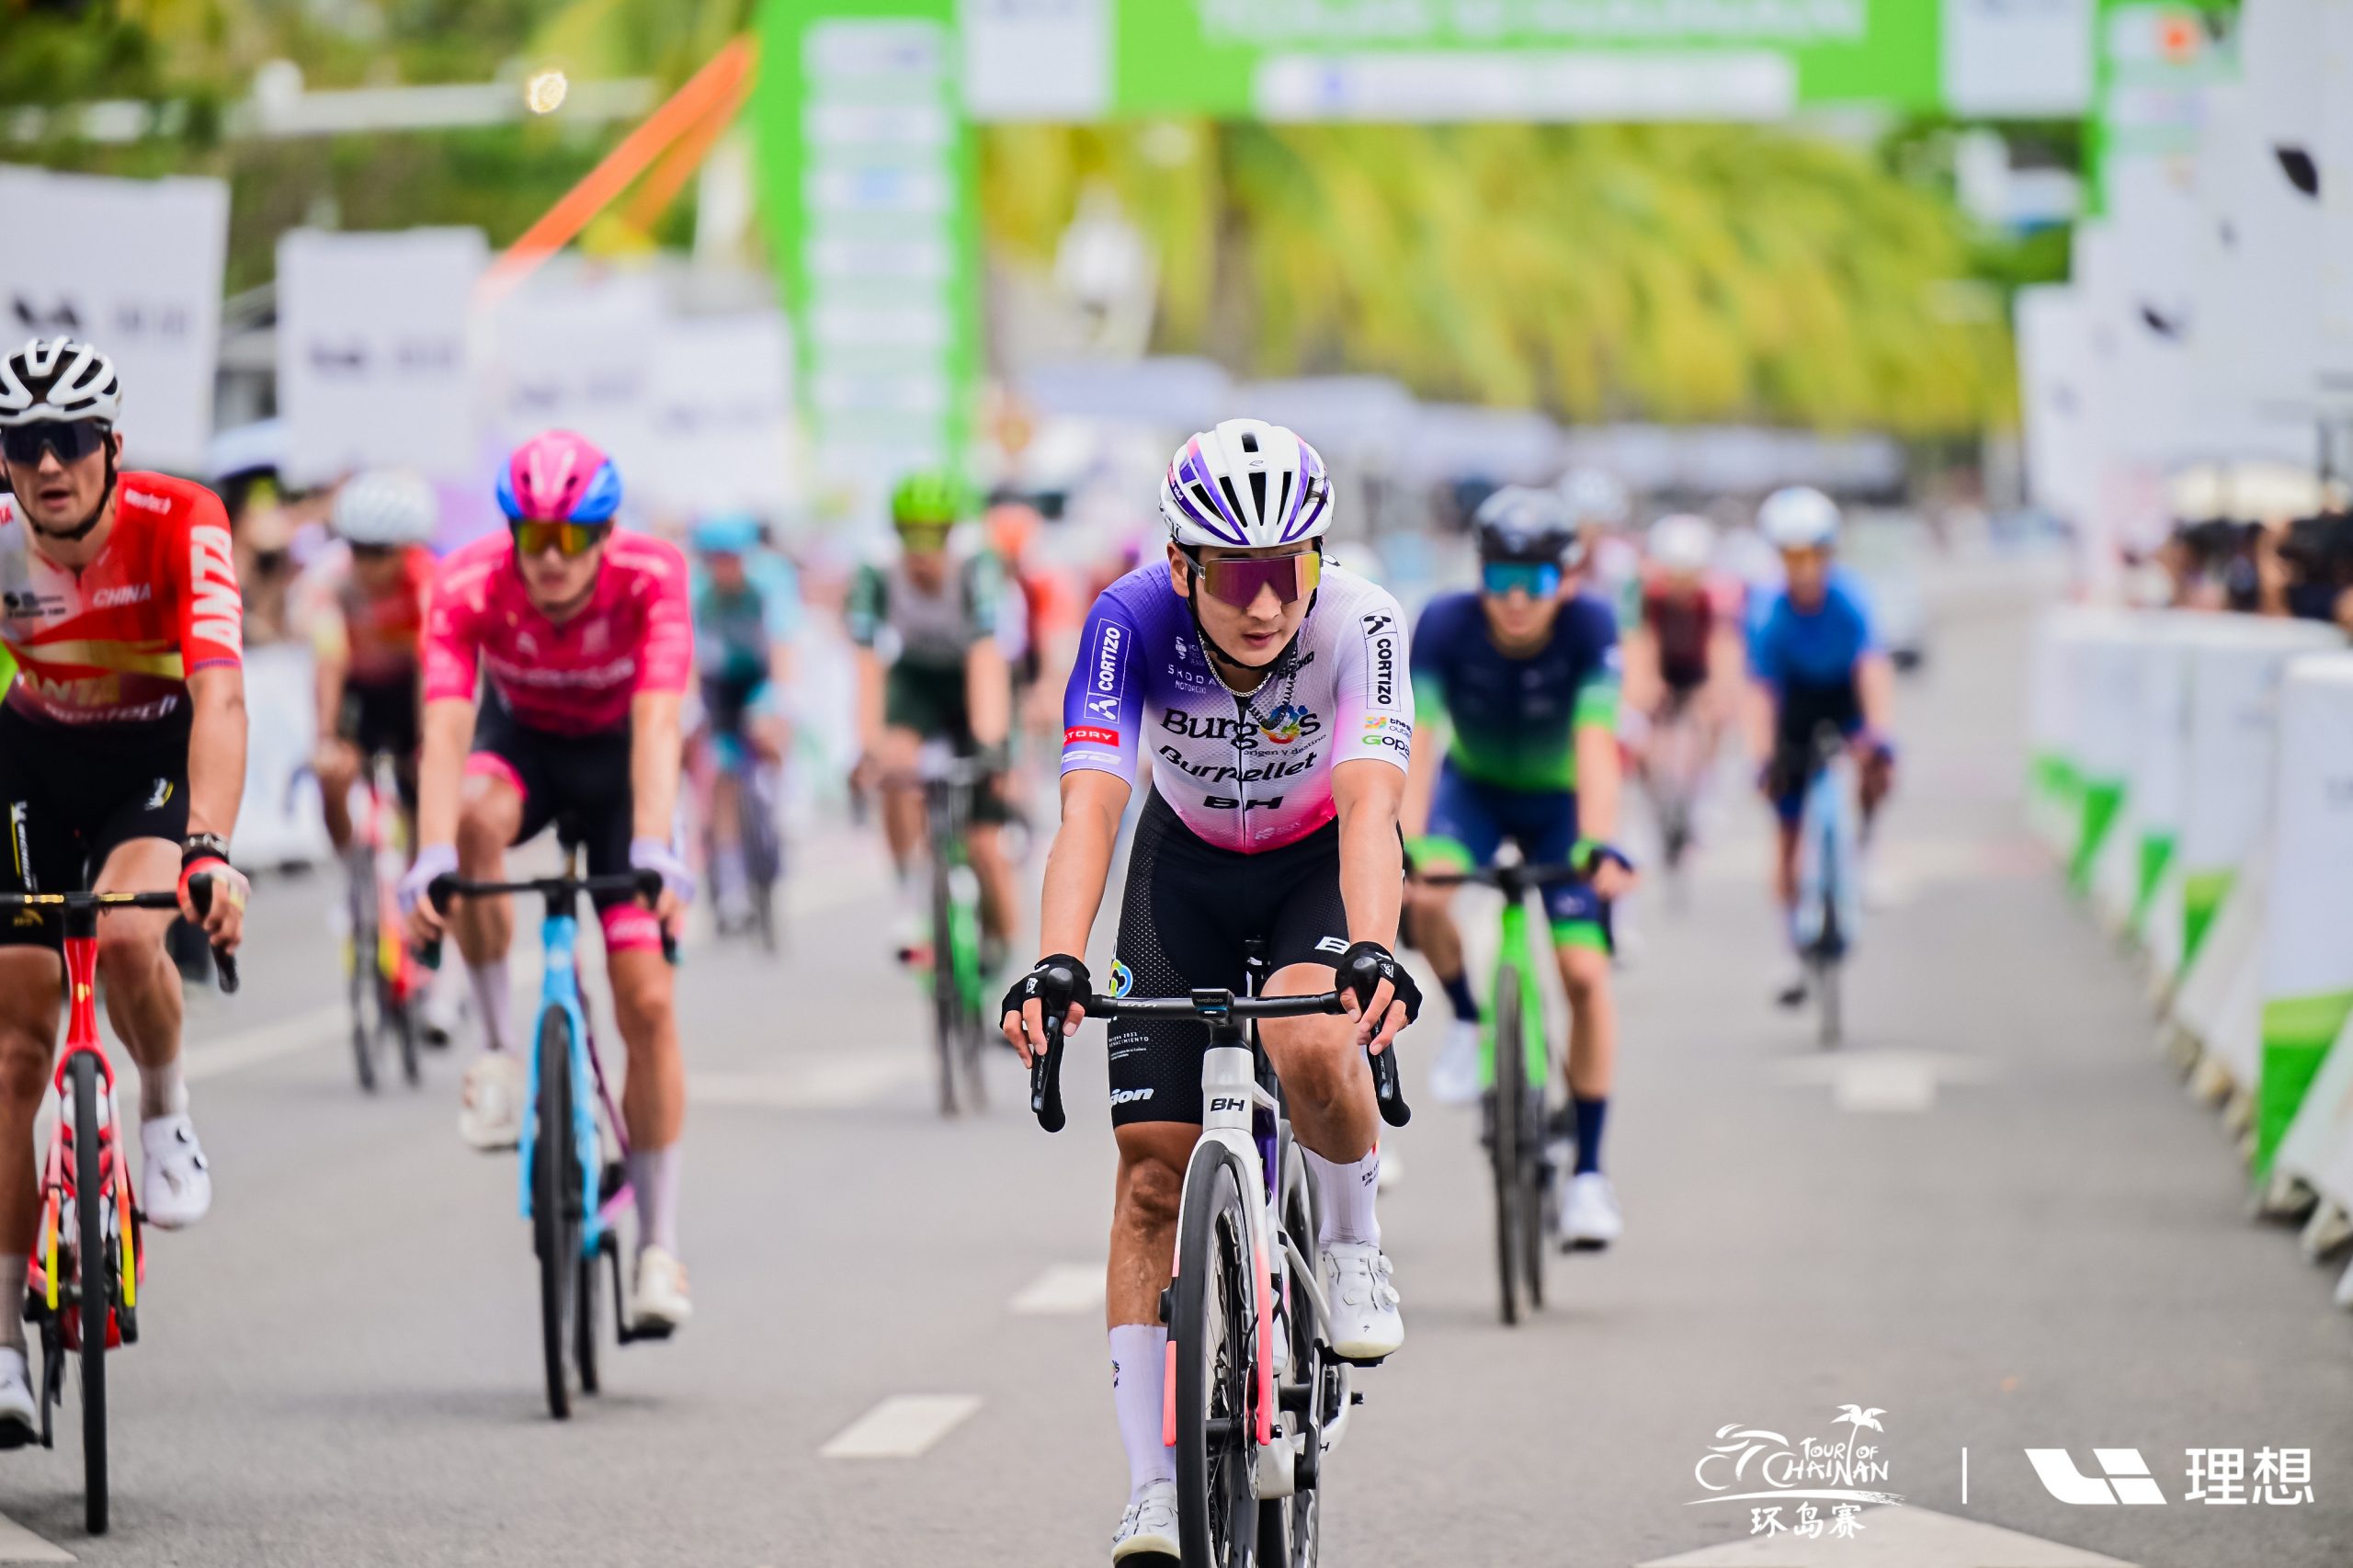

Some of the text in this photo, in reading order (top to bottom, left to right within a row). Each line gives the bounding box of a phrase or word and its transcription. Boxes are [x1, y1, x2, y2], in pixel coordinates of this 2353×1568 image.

[93, 582, 152, 608] CHINA
[190, 525, 243, 659] ANTA
[1097, 627, 1121, 691] CORTIZO
[1377, 638, 1392, 705] CORTIZO
[1159, 744, 1317, 783] Burpellet
[1203, 795, 1284, 812] BH
[1314, 936, 1350, 955] B
[1211, 1098, 1245, 1112] BH
